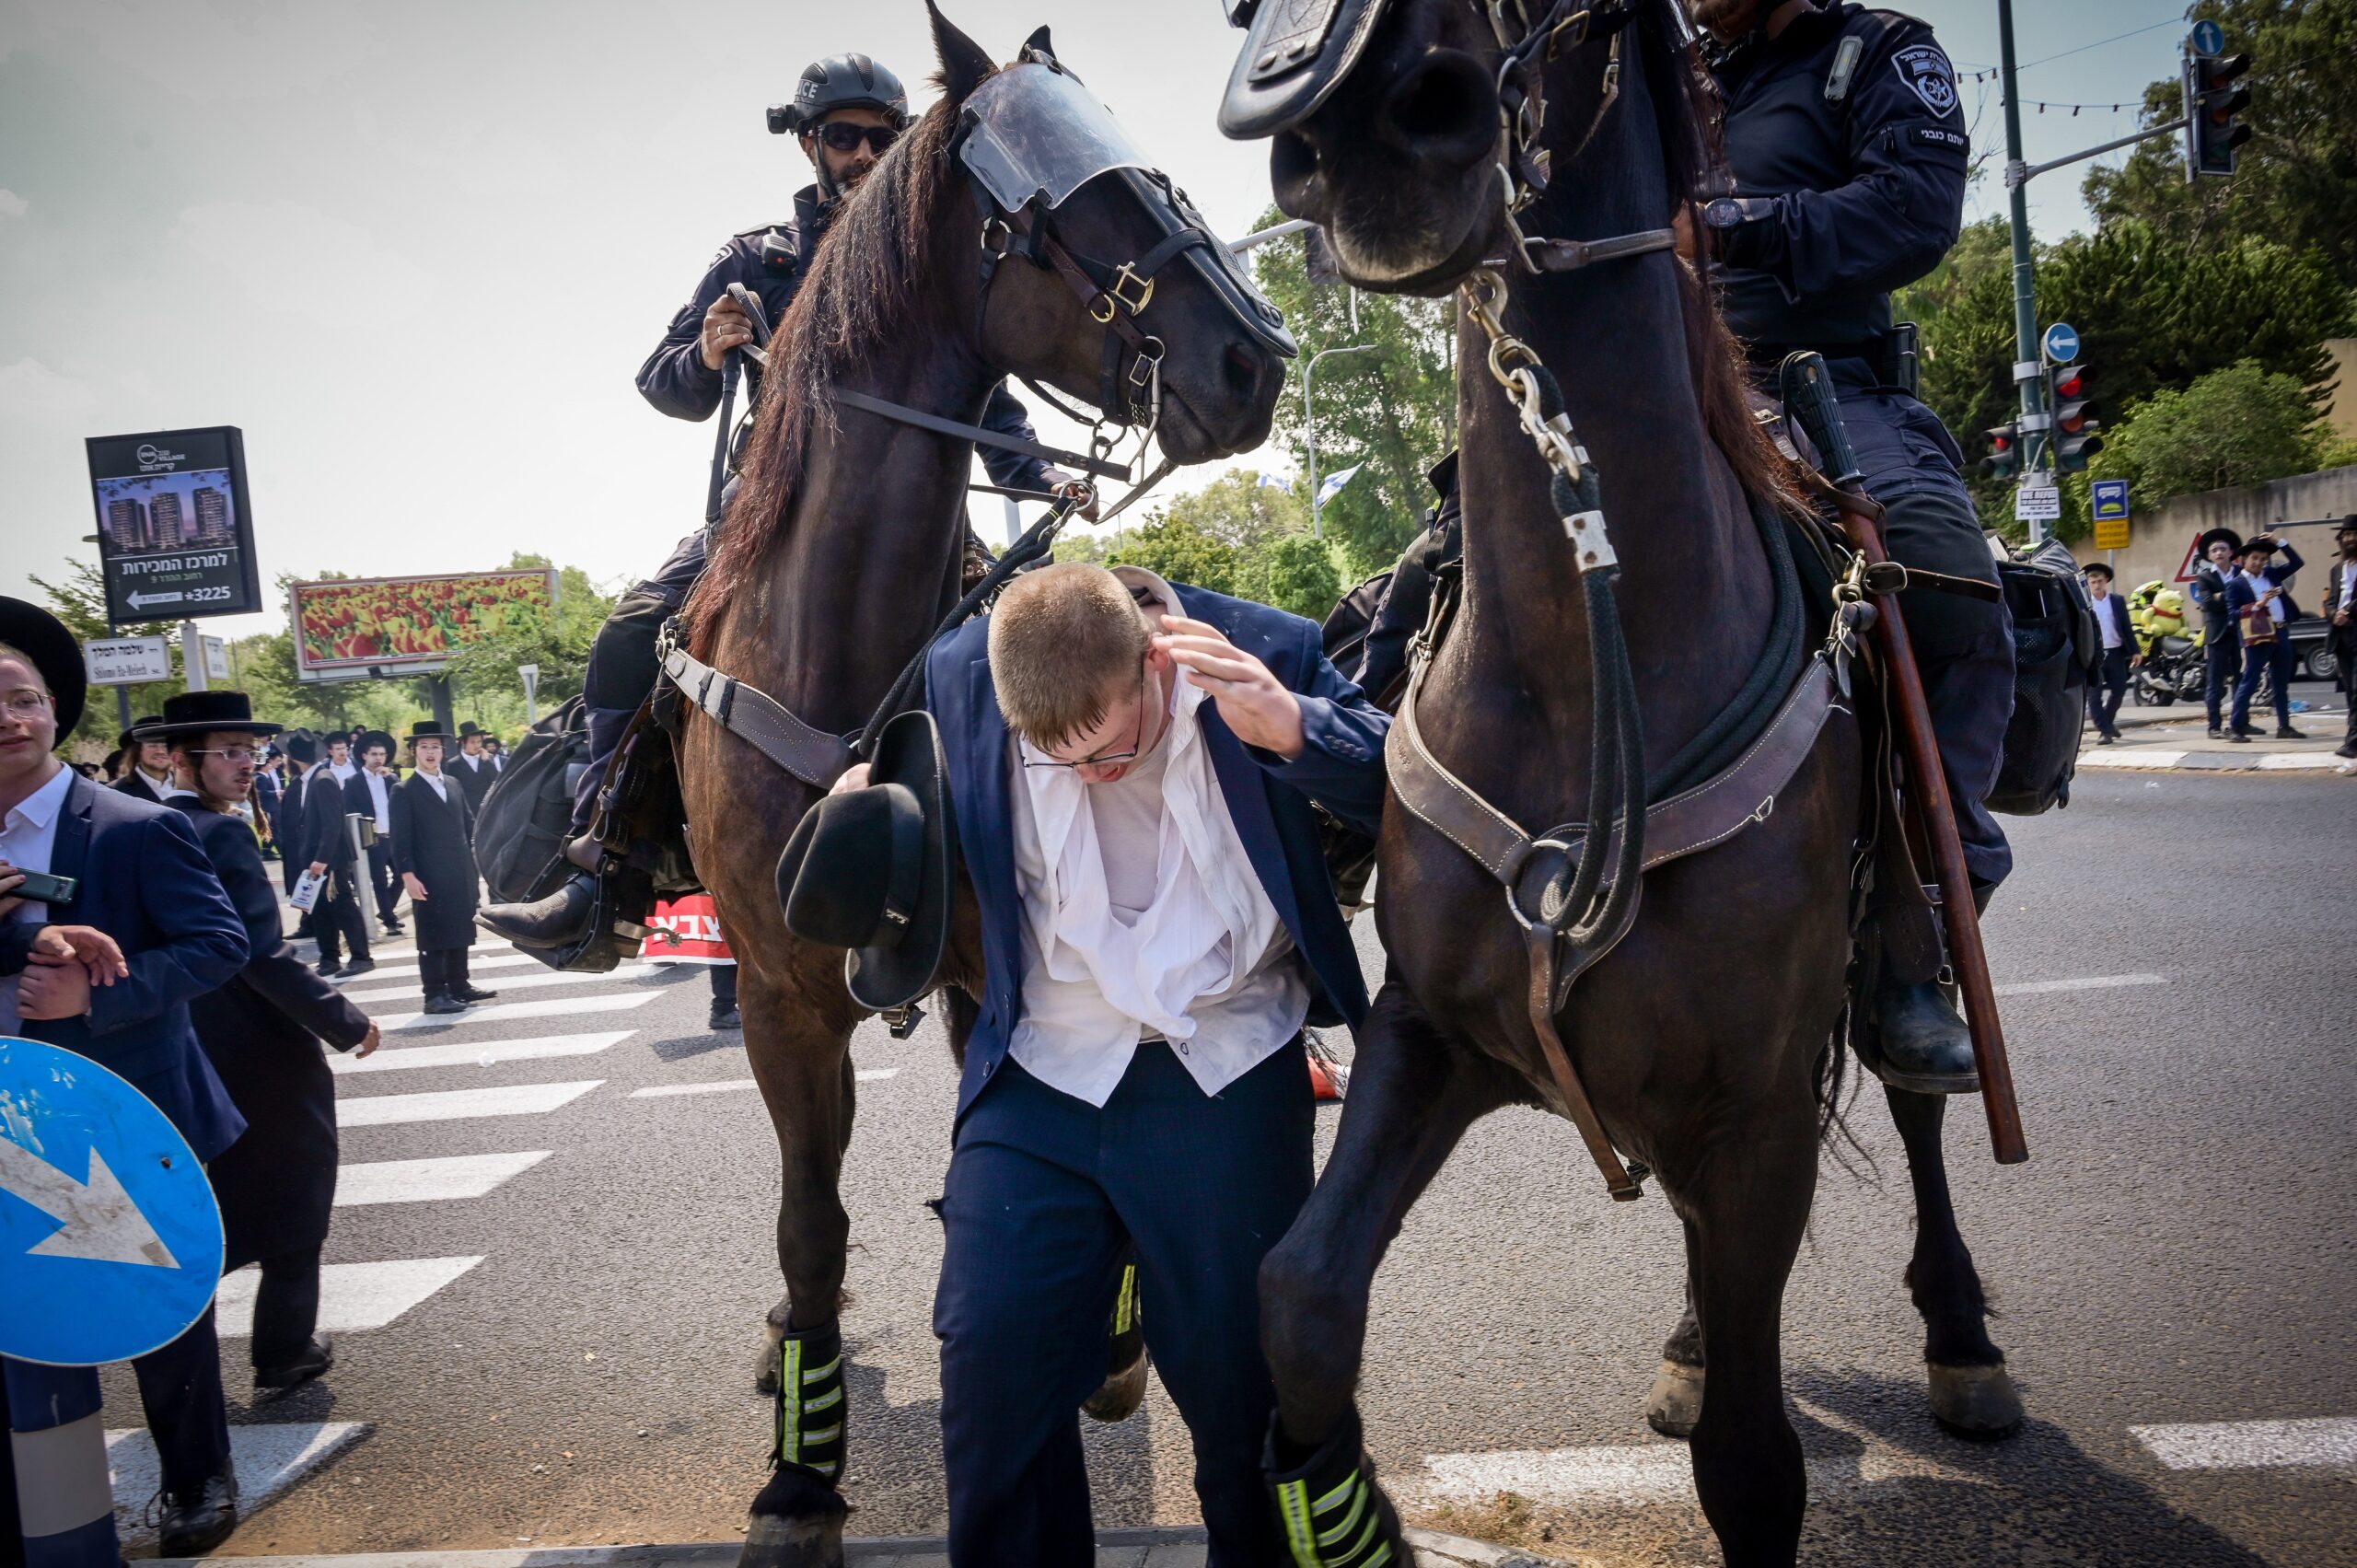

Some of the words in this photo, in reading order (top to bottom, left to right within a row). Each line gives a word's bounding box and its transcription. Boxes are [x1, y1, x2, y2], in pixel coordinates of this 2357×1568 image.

[122, 558, 182, 575] המכירות
[185, 552, 227, 569] למרכז
[92, 646, 117, 660] המלך
[119, 644, 145, 656] שלמה
